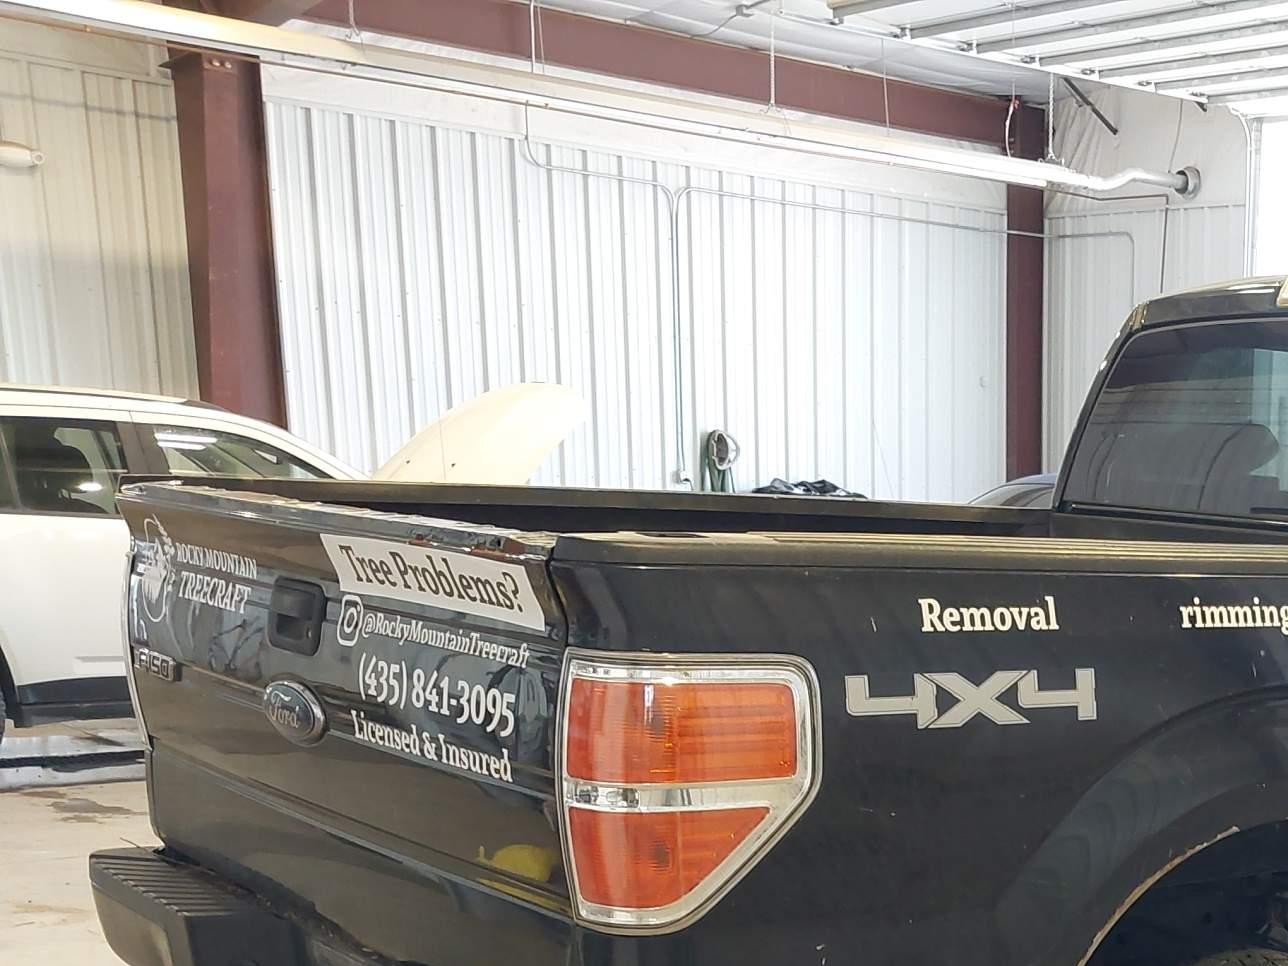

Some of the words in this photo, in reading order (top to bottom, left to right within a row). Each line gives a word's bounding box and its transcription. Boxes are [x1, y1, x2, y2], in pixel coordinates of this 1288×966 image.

[176, 542, 204, 566] ROCKY
[204, 548, 257, 579] MOUNTAIN
[338, 544, 398, 588] Tree
[388, 551, 524, 613] Problems?
[178, 571, 251, 614] TREECRAFT
[918, 595, 1060, 632] Removal
[361, 612, 530, 669] @RockyMountainTreecraft
[269, 690, 300, 729] Ford
[358, 652, 407, 710] (435)
[411, 668, 516, 737] 841-3095
[350, 708, 421, 756] Licensed
[422, 731, 438, 761] &
[438, 734, 513, 782] Insured
